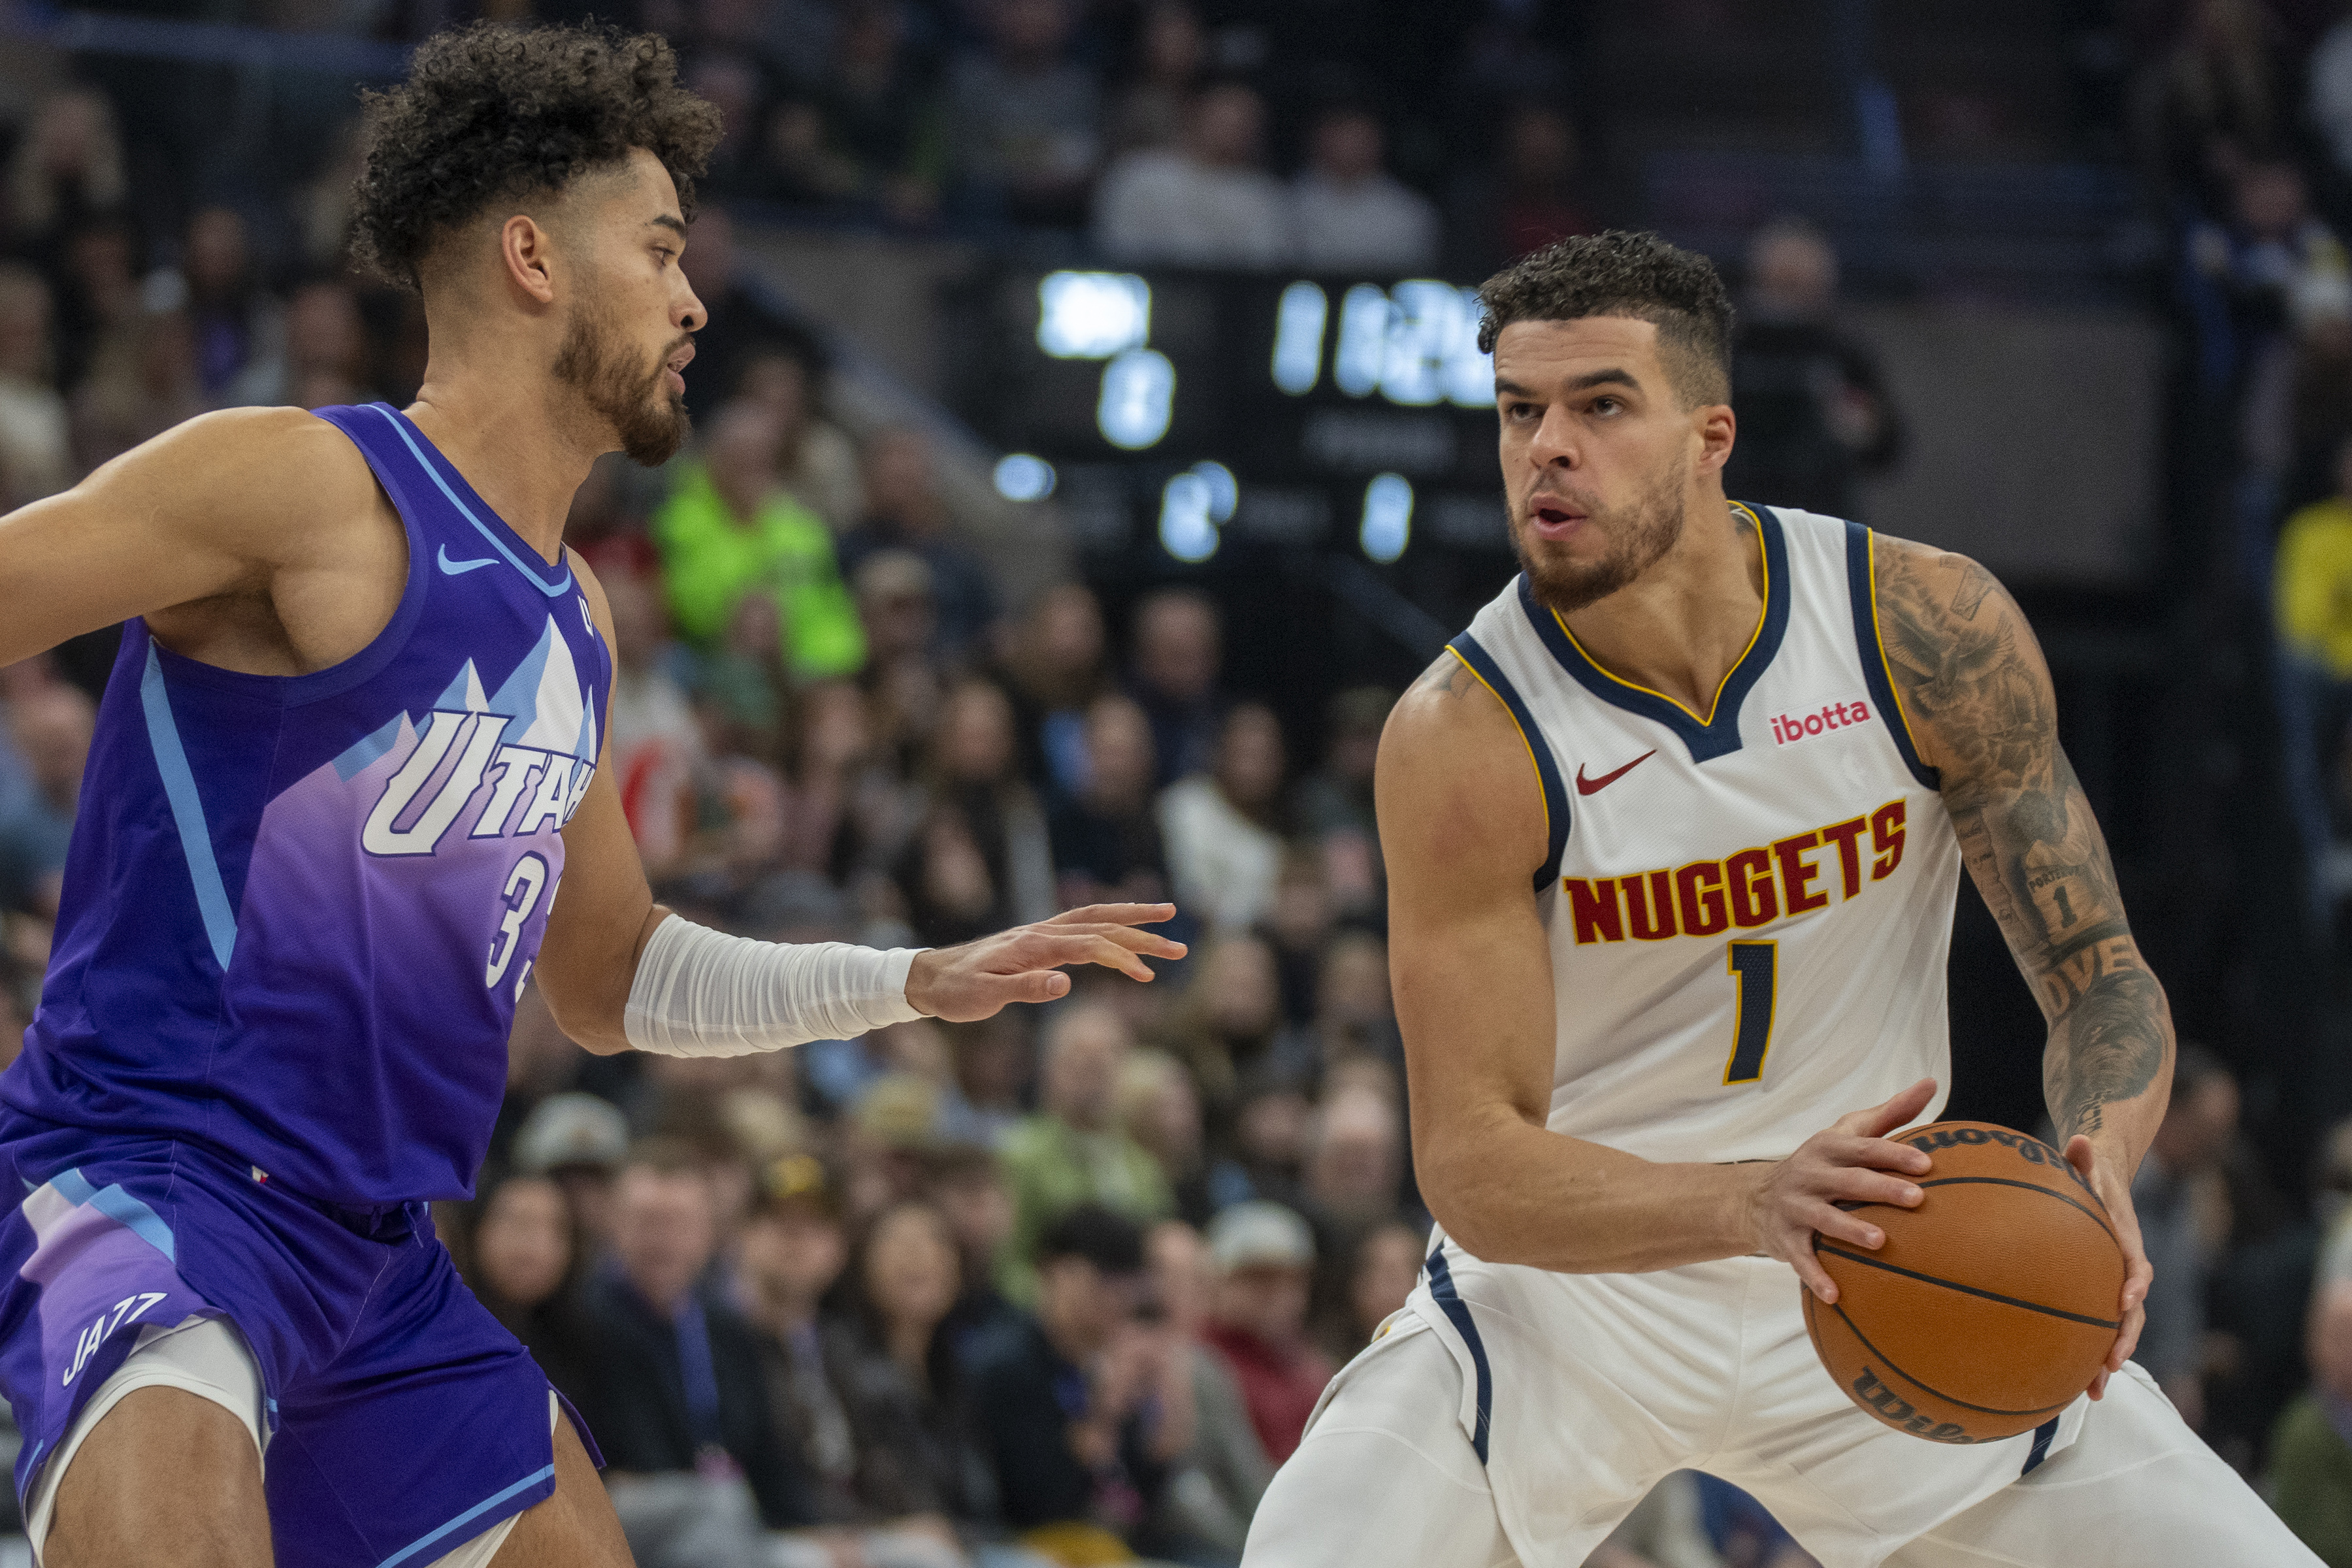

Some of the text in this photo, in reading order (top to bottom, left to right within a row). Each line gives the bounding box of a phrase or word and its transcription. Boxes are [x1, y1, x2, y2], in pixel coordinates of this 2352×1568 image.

[361, 708, 597, 857] UTAH
[1770, 701, 1871, 745] ibotta
[1563, 797, 1907, 946] NUGGETS
[2053, 886, 2078, 928] 1
[1723, 939, 1778, 1086] 1
